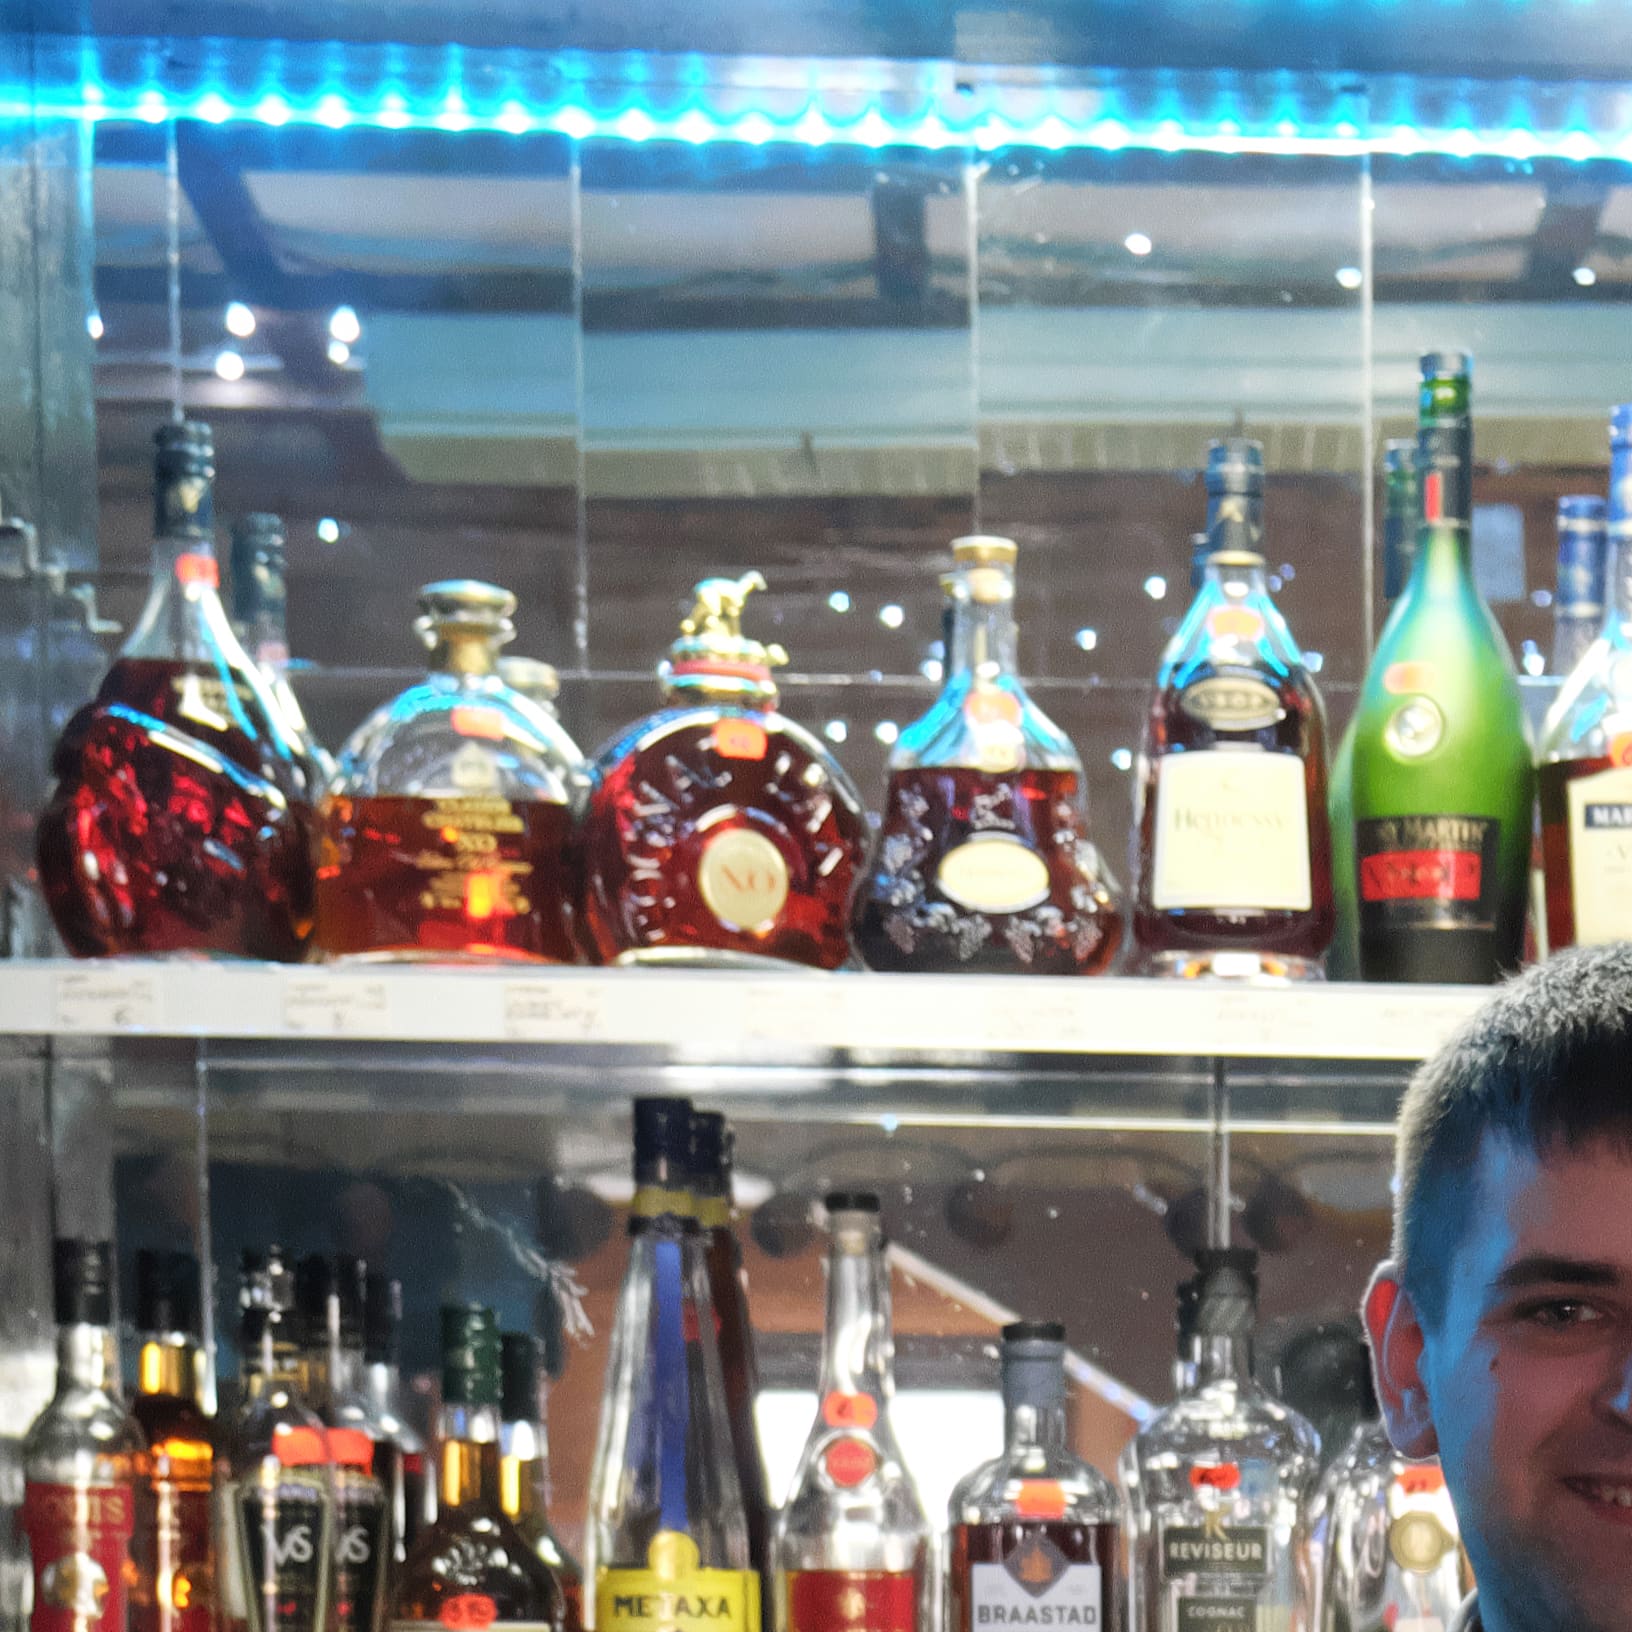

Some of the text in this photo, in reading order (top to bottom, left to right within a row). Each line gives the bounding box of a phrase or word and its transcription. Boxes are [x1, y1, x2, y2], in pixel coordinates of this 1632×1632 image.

[1168, 1542, 1262, 1561] REVISEUR
[613, 1595, 732, 1618] METAXA
[977, 1604, 1097, 1626] BRAASTAD
[1187, 1605, 1245, 1618] COGNAC
